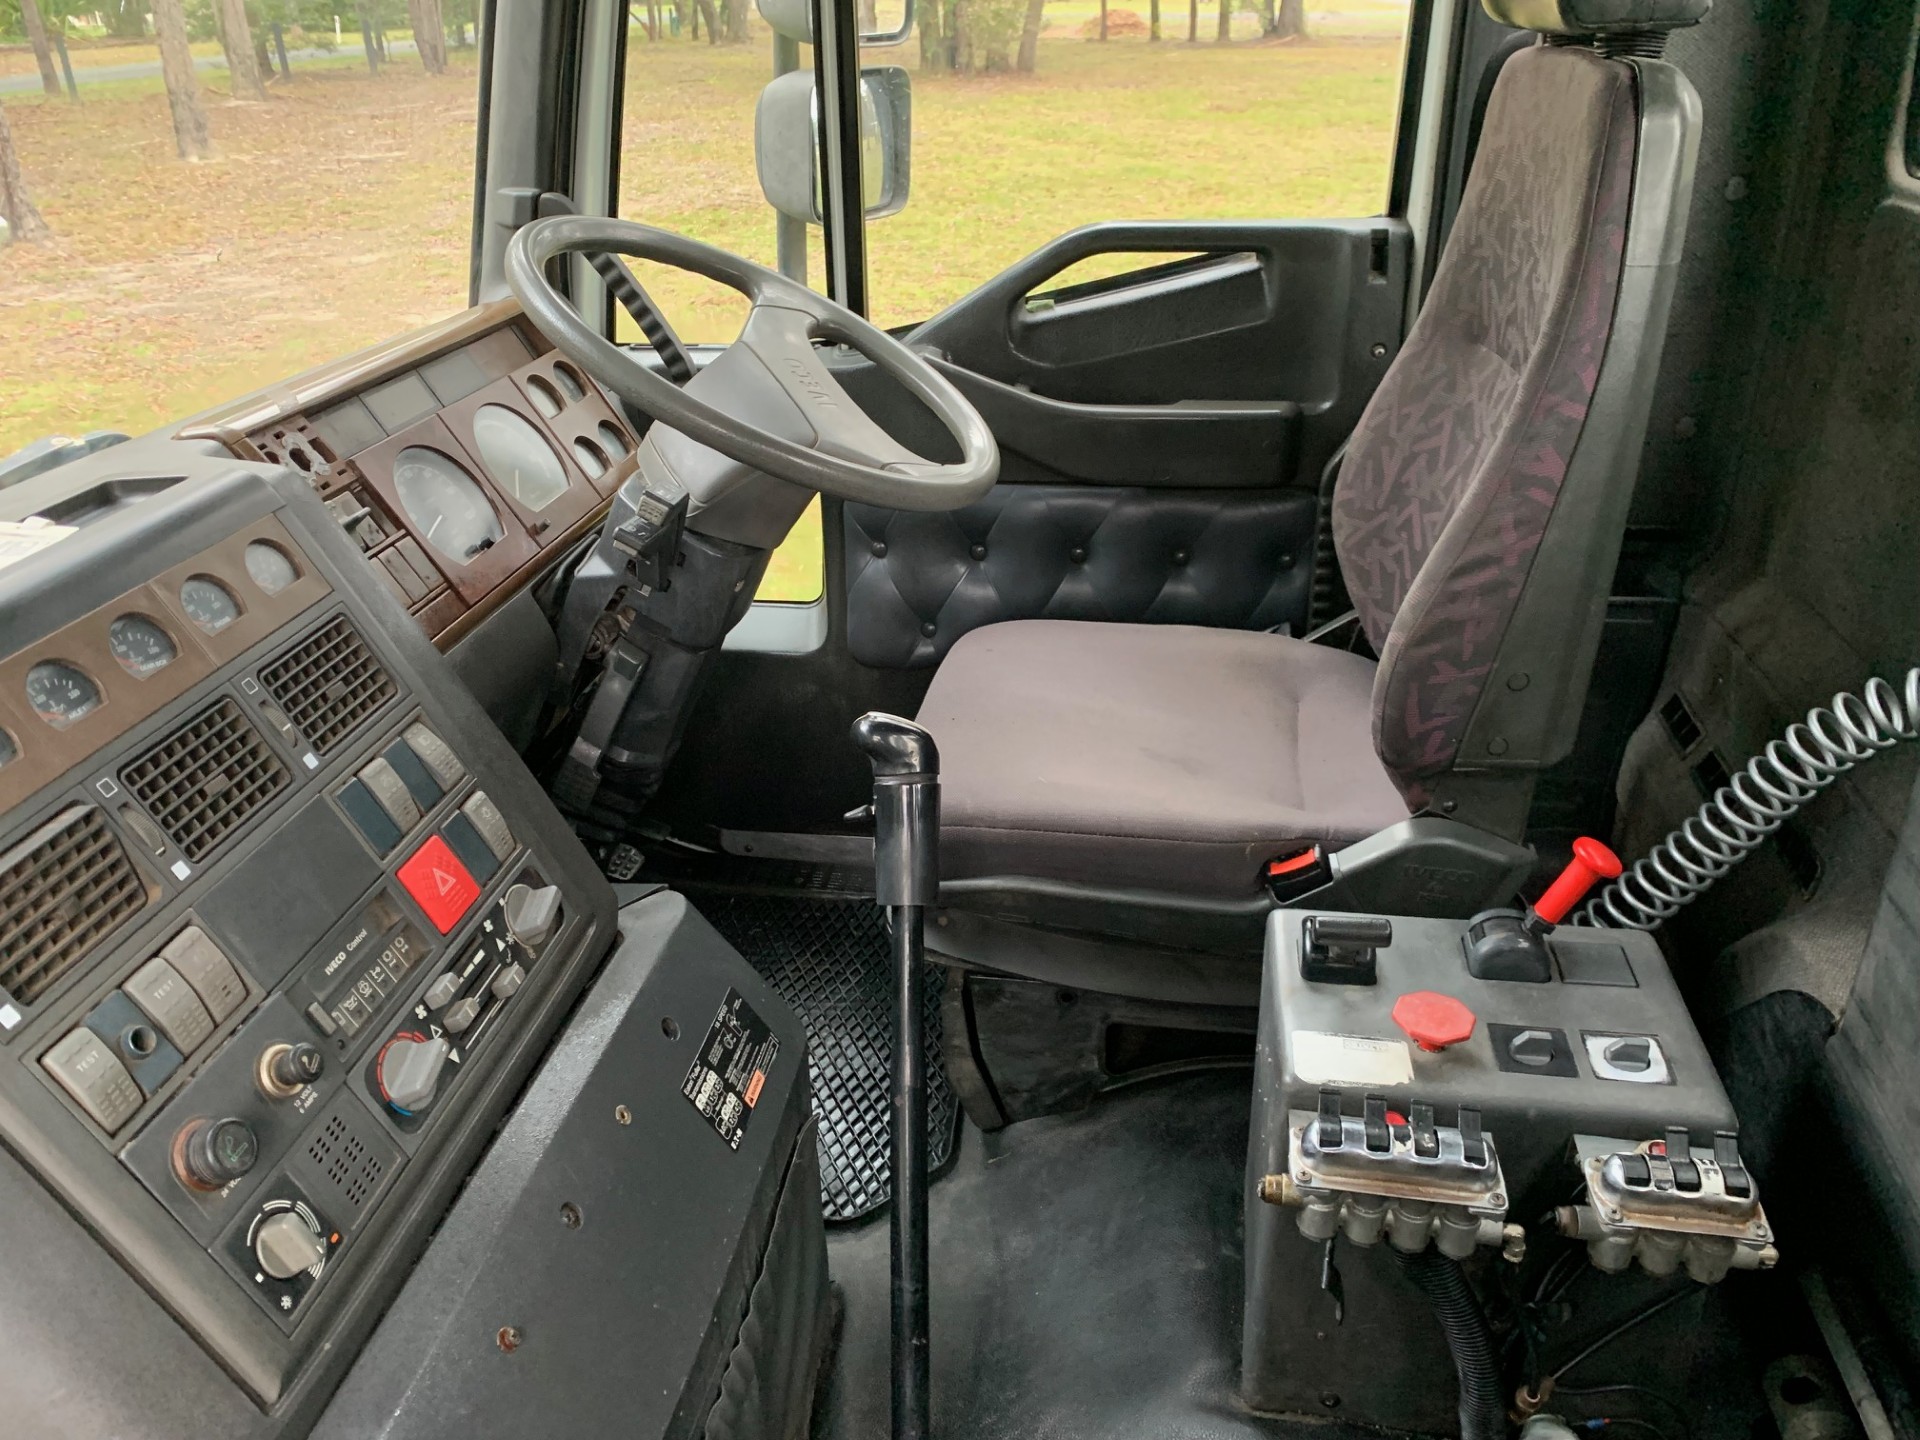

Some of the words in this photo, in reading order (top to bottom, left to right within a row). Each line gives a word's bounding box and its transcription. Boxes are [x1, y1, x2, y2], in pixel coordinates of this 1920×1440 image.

[324, 950, 347, 975] IVECO
[346, 928, 368, 951] Control
[153, 979, 175, 1000] TEST
[718, 1004, 728, 1022] SPEED
[76, 1049, 99, 1073] TEST
[299, 1085, 313, 1100] VOLT
[302, 1091, 318, 1108] AMPS
